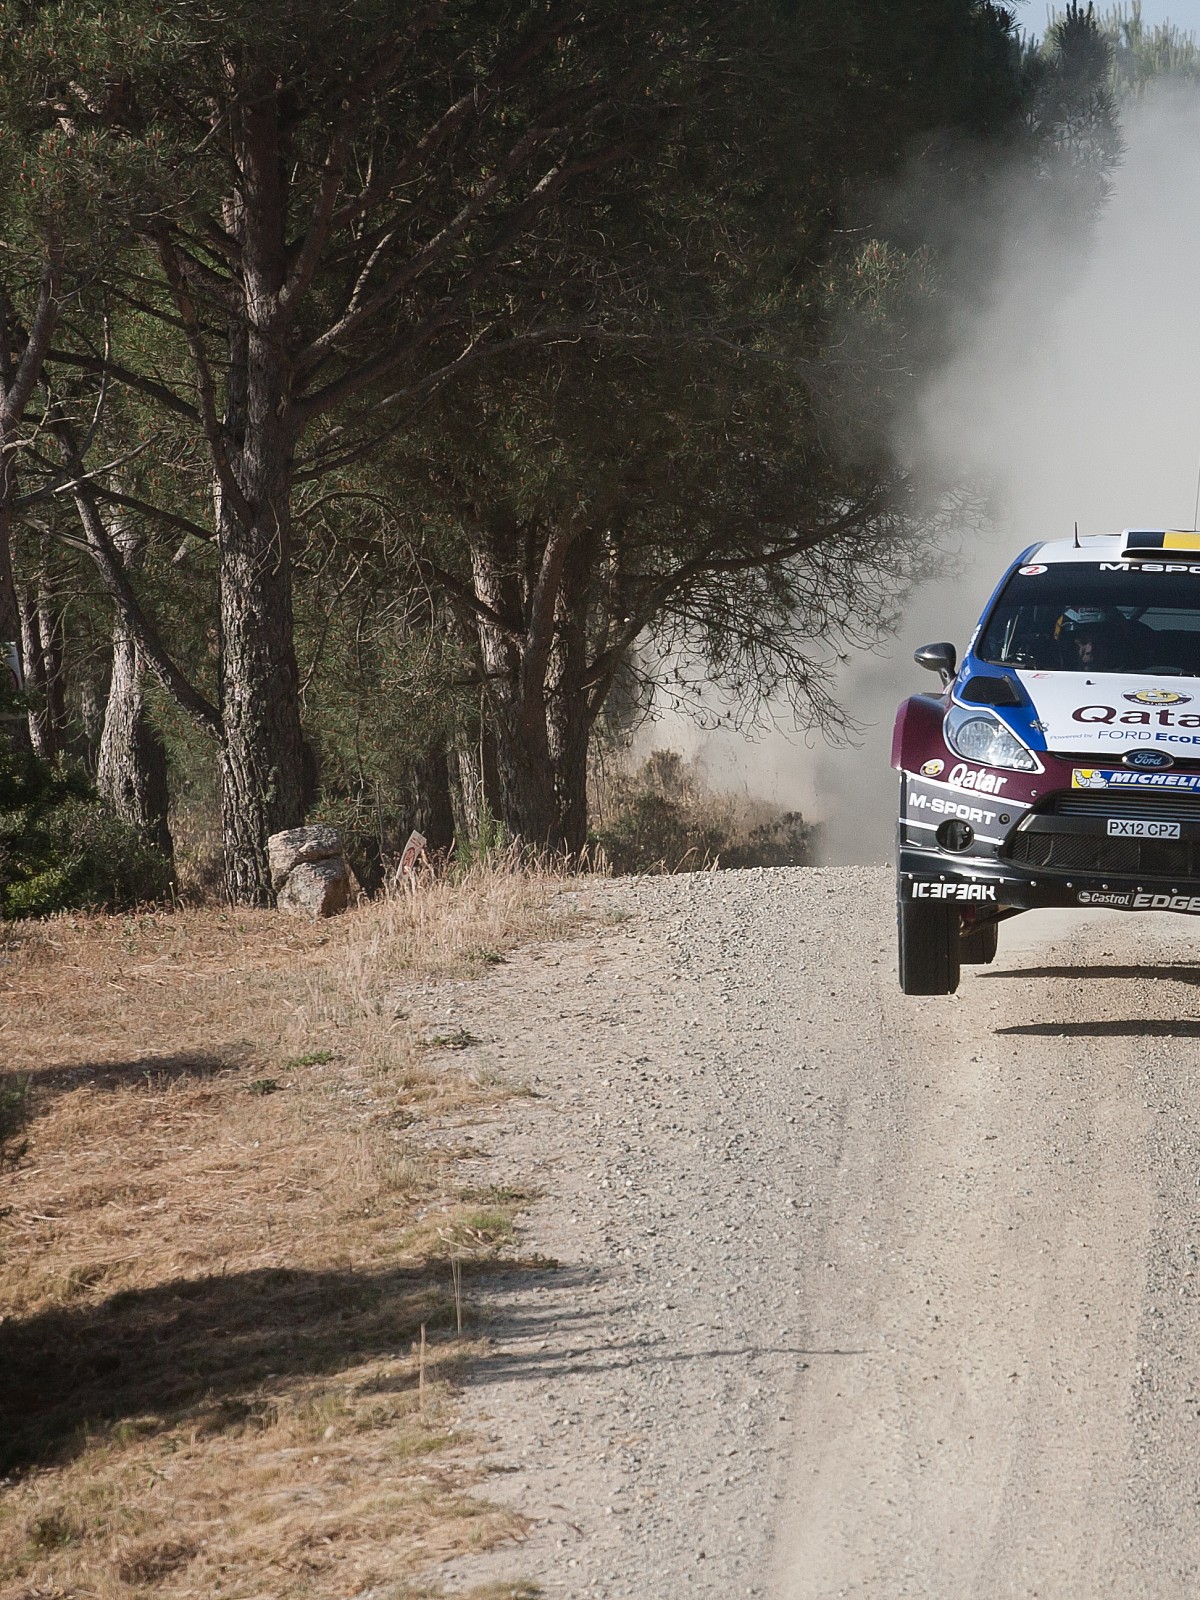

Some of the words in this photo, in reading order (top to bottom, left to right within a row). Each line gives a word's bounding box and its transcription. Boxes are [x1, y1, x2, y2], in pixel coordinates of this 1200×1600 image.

[1098, 730, 1151, 741] FORD
[1134, 752, 1163, 766] Ford
[948, 763, 1008, 794] Qatar
[909, 793, 997, 825] M-SPORT
[1109, 821, 1144, 835] PX12
[1147, 823, 1179, 837] CPZ
[1091, 892, 1130, 905] Castrol
